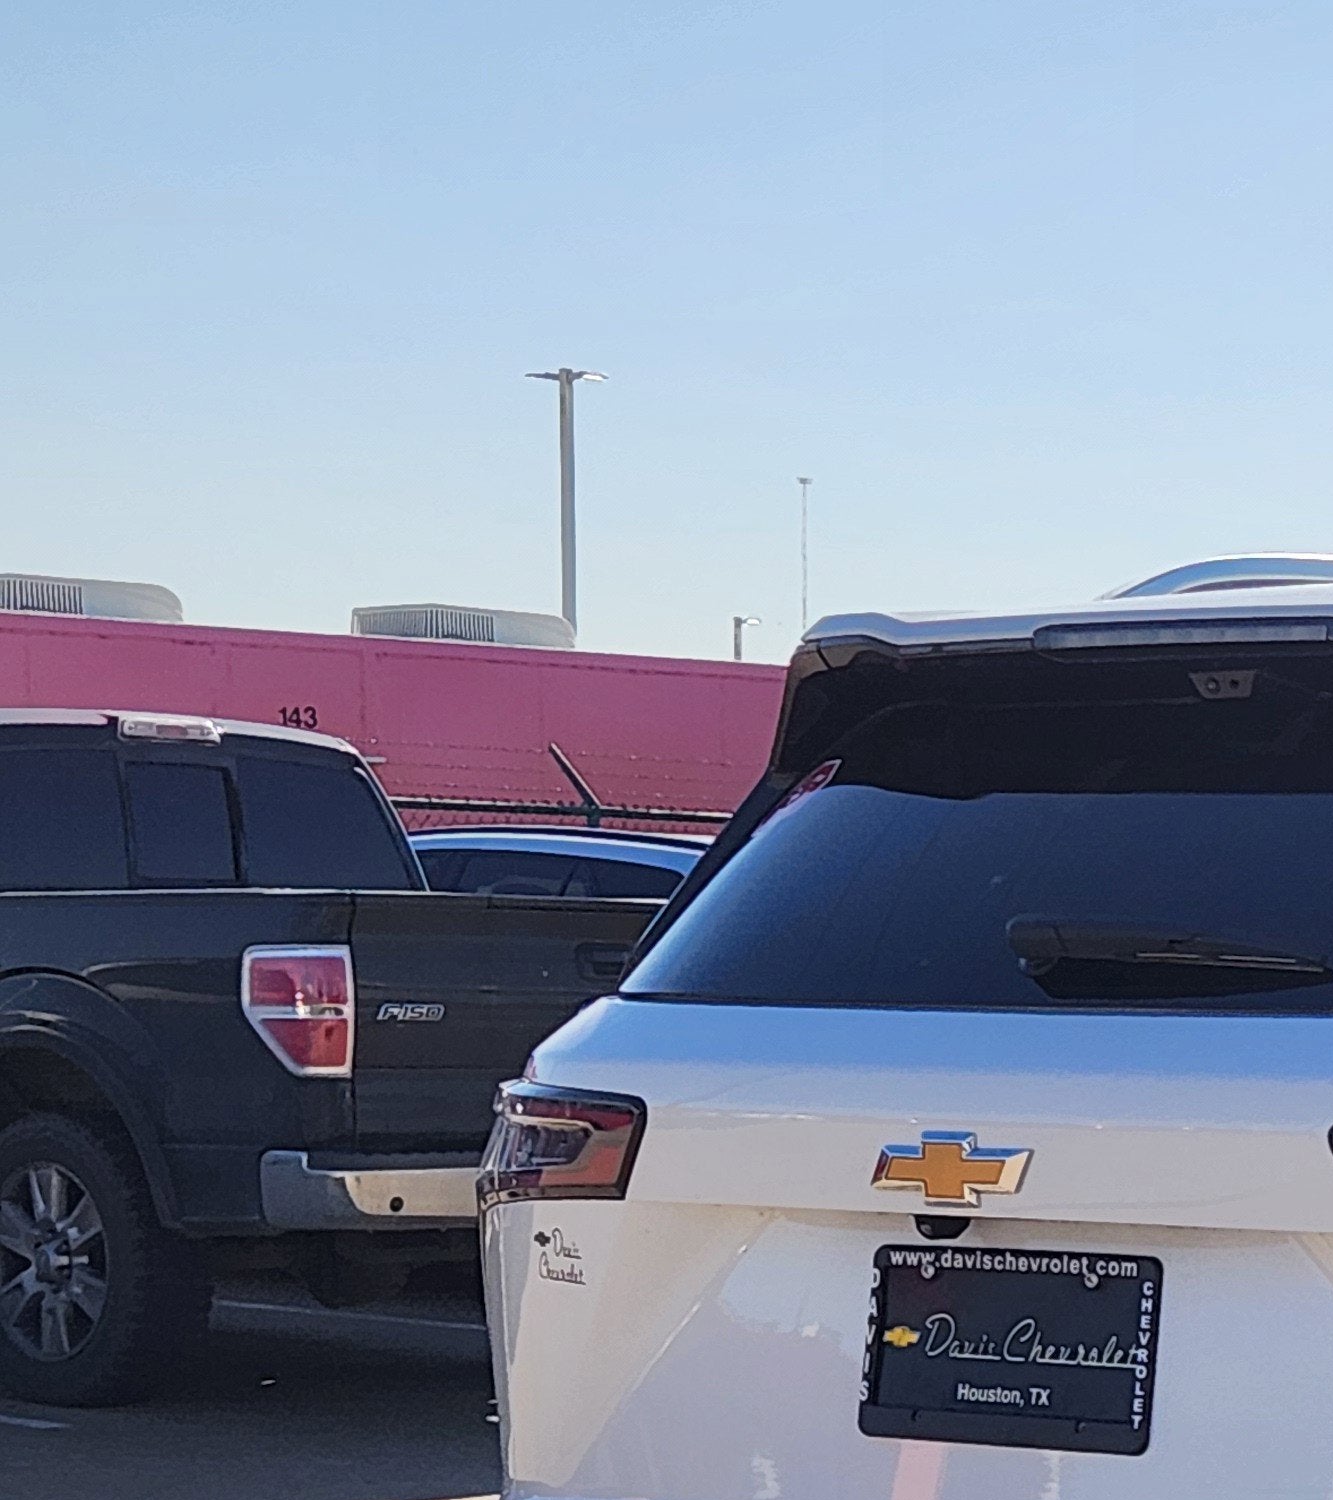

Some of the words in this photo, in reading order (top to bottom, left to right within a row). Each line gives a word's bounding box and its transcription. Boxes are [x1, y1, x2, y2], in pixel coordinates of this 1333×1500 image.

[278, 705, 318, 729] 143
[889, 1249, 1138, 1278] www.davischevrolet.com
[859, 1268, 881, 1401] DAVIS
[925, 1313, 1001, 1360] Davis
[1003, 1316, 1140, 1368] Chevrolet
[1131, 1281, 1154, 1430] CHEVROLET
[956, 1383, 1025, 1408] Houston,
[1028, 1387, 1051, 1406] TX
